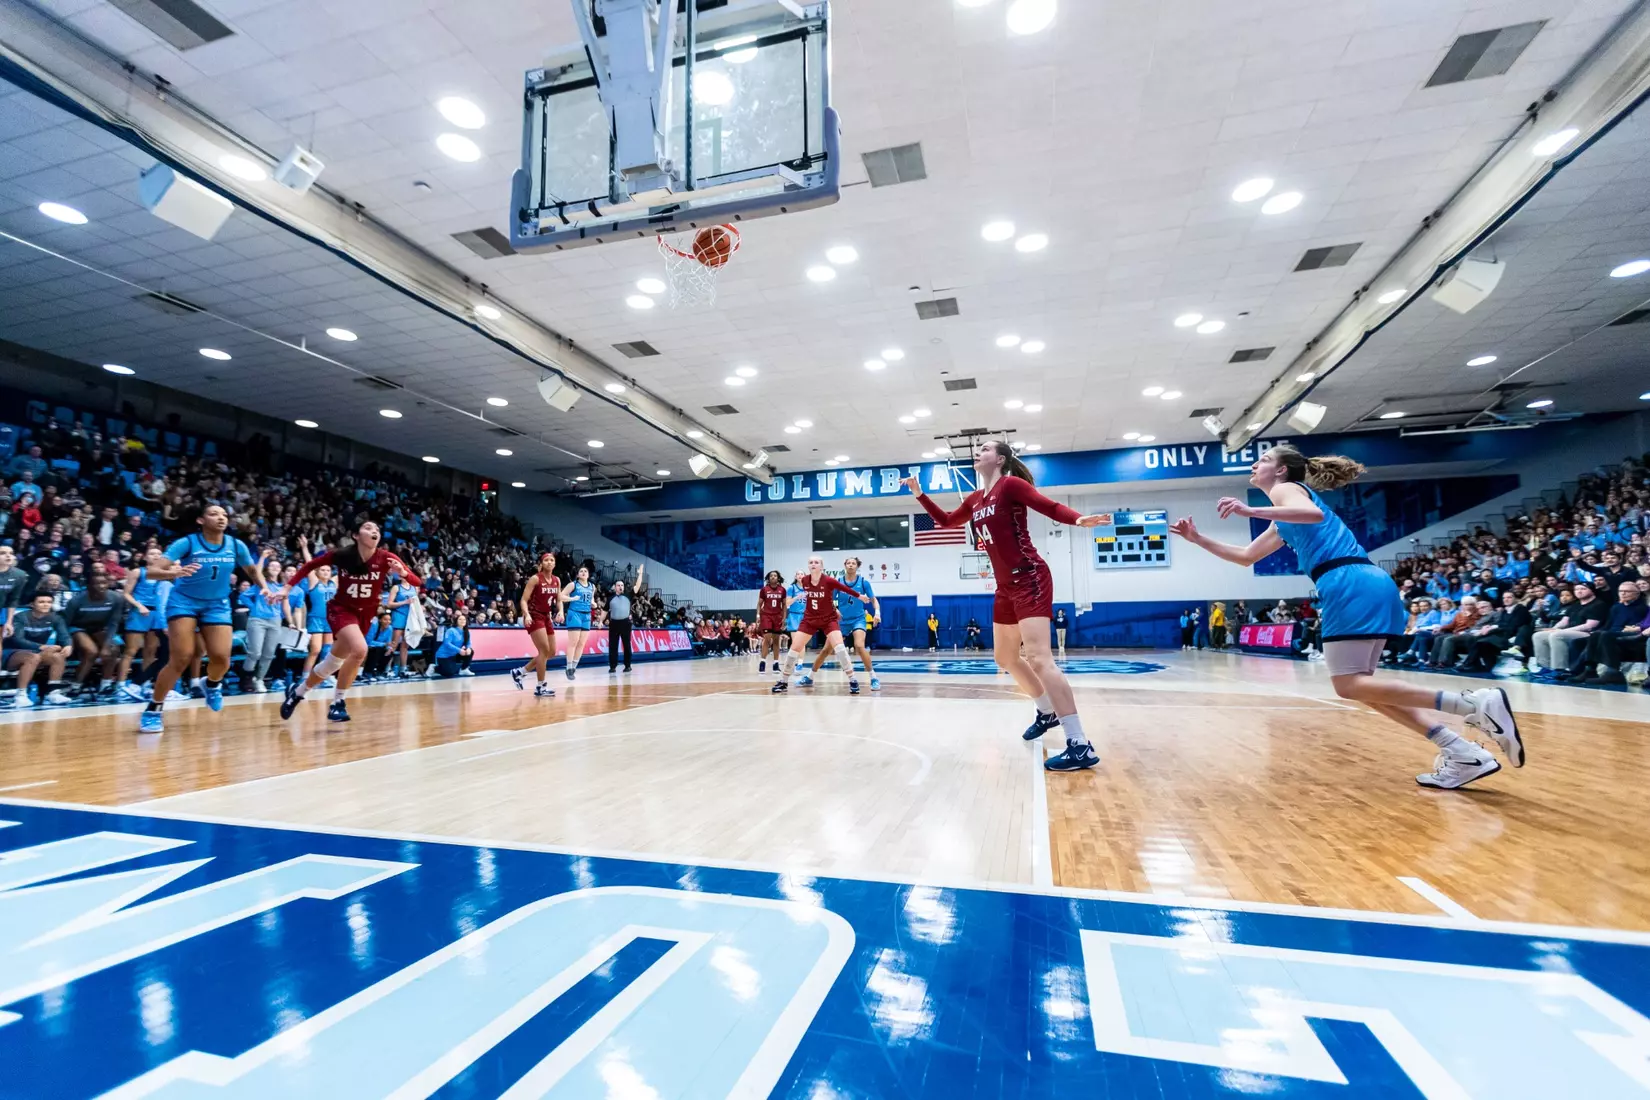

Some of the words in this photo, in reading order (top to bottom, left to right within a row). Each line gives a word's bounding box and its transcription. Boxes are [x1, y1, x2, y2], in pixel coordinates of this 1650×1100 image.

[1144, 445, 1208, 469] ONLY
[210, 565, 219, 581] 1
[346, 583, 373, 598] 45
[771, 599, 777, 608] 0
[811, 599, 819, 610] 5
